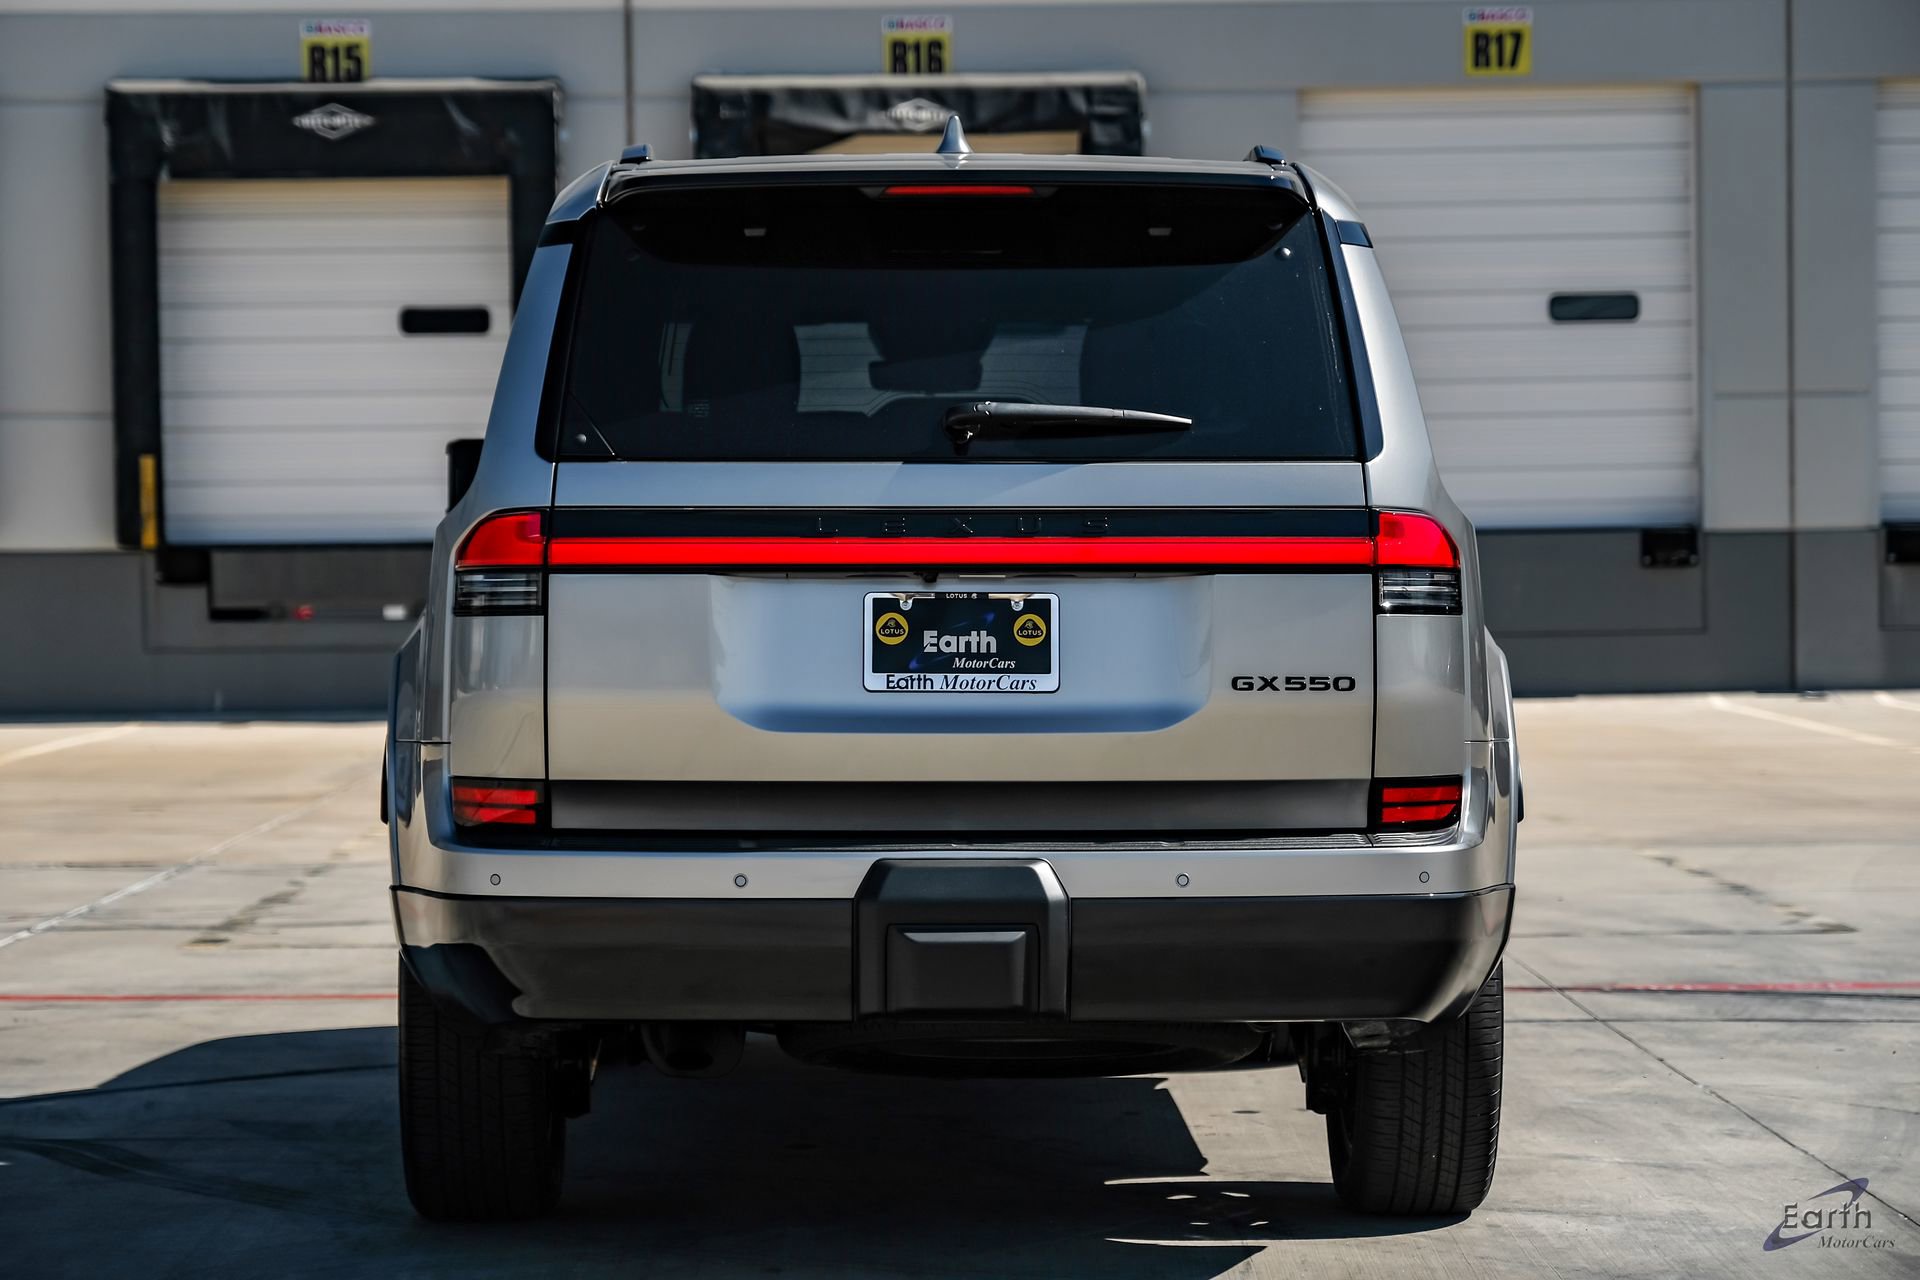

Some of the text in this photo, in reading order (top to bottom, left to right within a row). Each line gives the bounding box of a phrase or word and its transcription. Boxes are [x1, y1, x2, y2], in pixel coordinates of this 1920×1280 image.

[892, 40, 943, 75] R16
[1474, 30, 1523, 68] R17
[309, 44, 362, 82] R15
[816, 515, 1109, 536] LEXUS
[880, 627, 905, 635] LOTUS
[923, 630, 997, 653] Earth
[1018, 629, 1043, 637] LOTUS
[952, 657, 1016, 669] MotorCars
[886, 674, 1037, 691] Earth MotorCars
